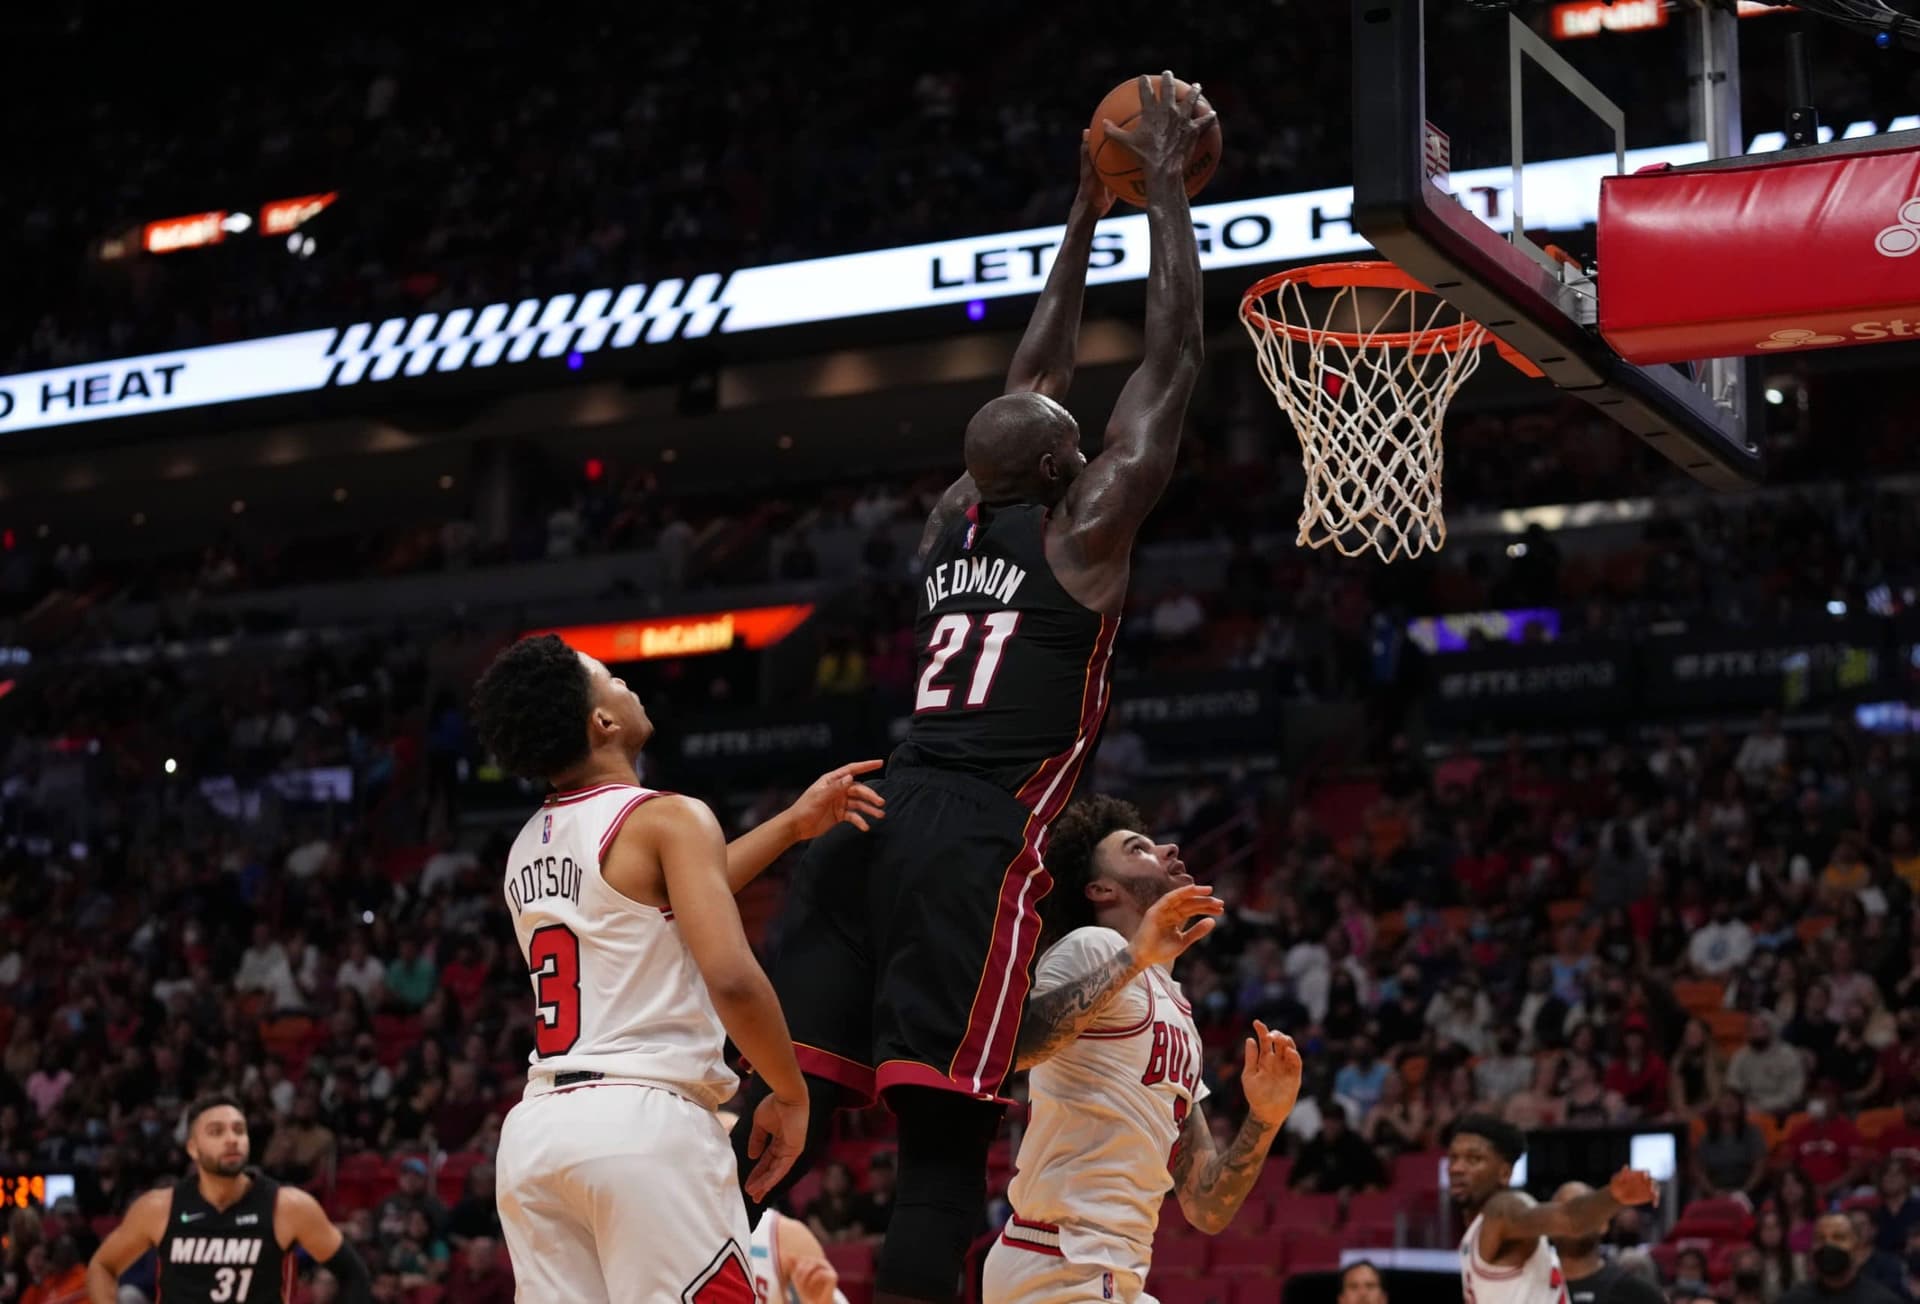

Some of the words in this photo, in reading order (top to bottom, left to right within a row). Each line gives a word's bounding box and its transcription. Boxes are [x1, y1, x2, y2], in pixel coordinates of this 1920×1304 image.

[41, 364, 185, 412] HEAT
[926, 556, 1027, 612] DEDMON
[914, 609, 1024, 715] 21
[509, 856, 583, 916] DOTSON
[529, 922, 581, 1059] 3
[170, 1237, 262, 1265] MIAMI
[210, 1267, 253, 1304] 31
